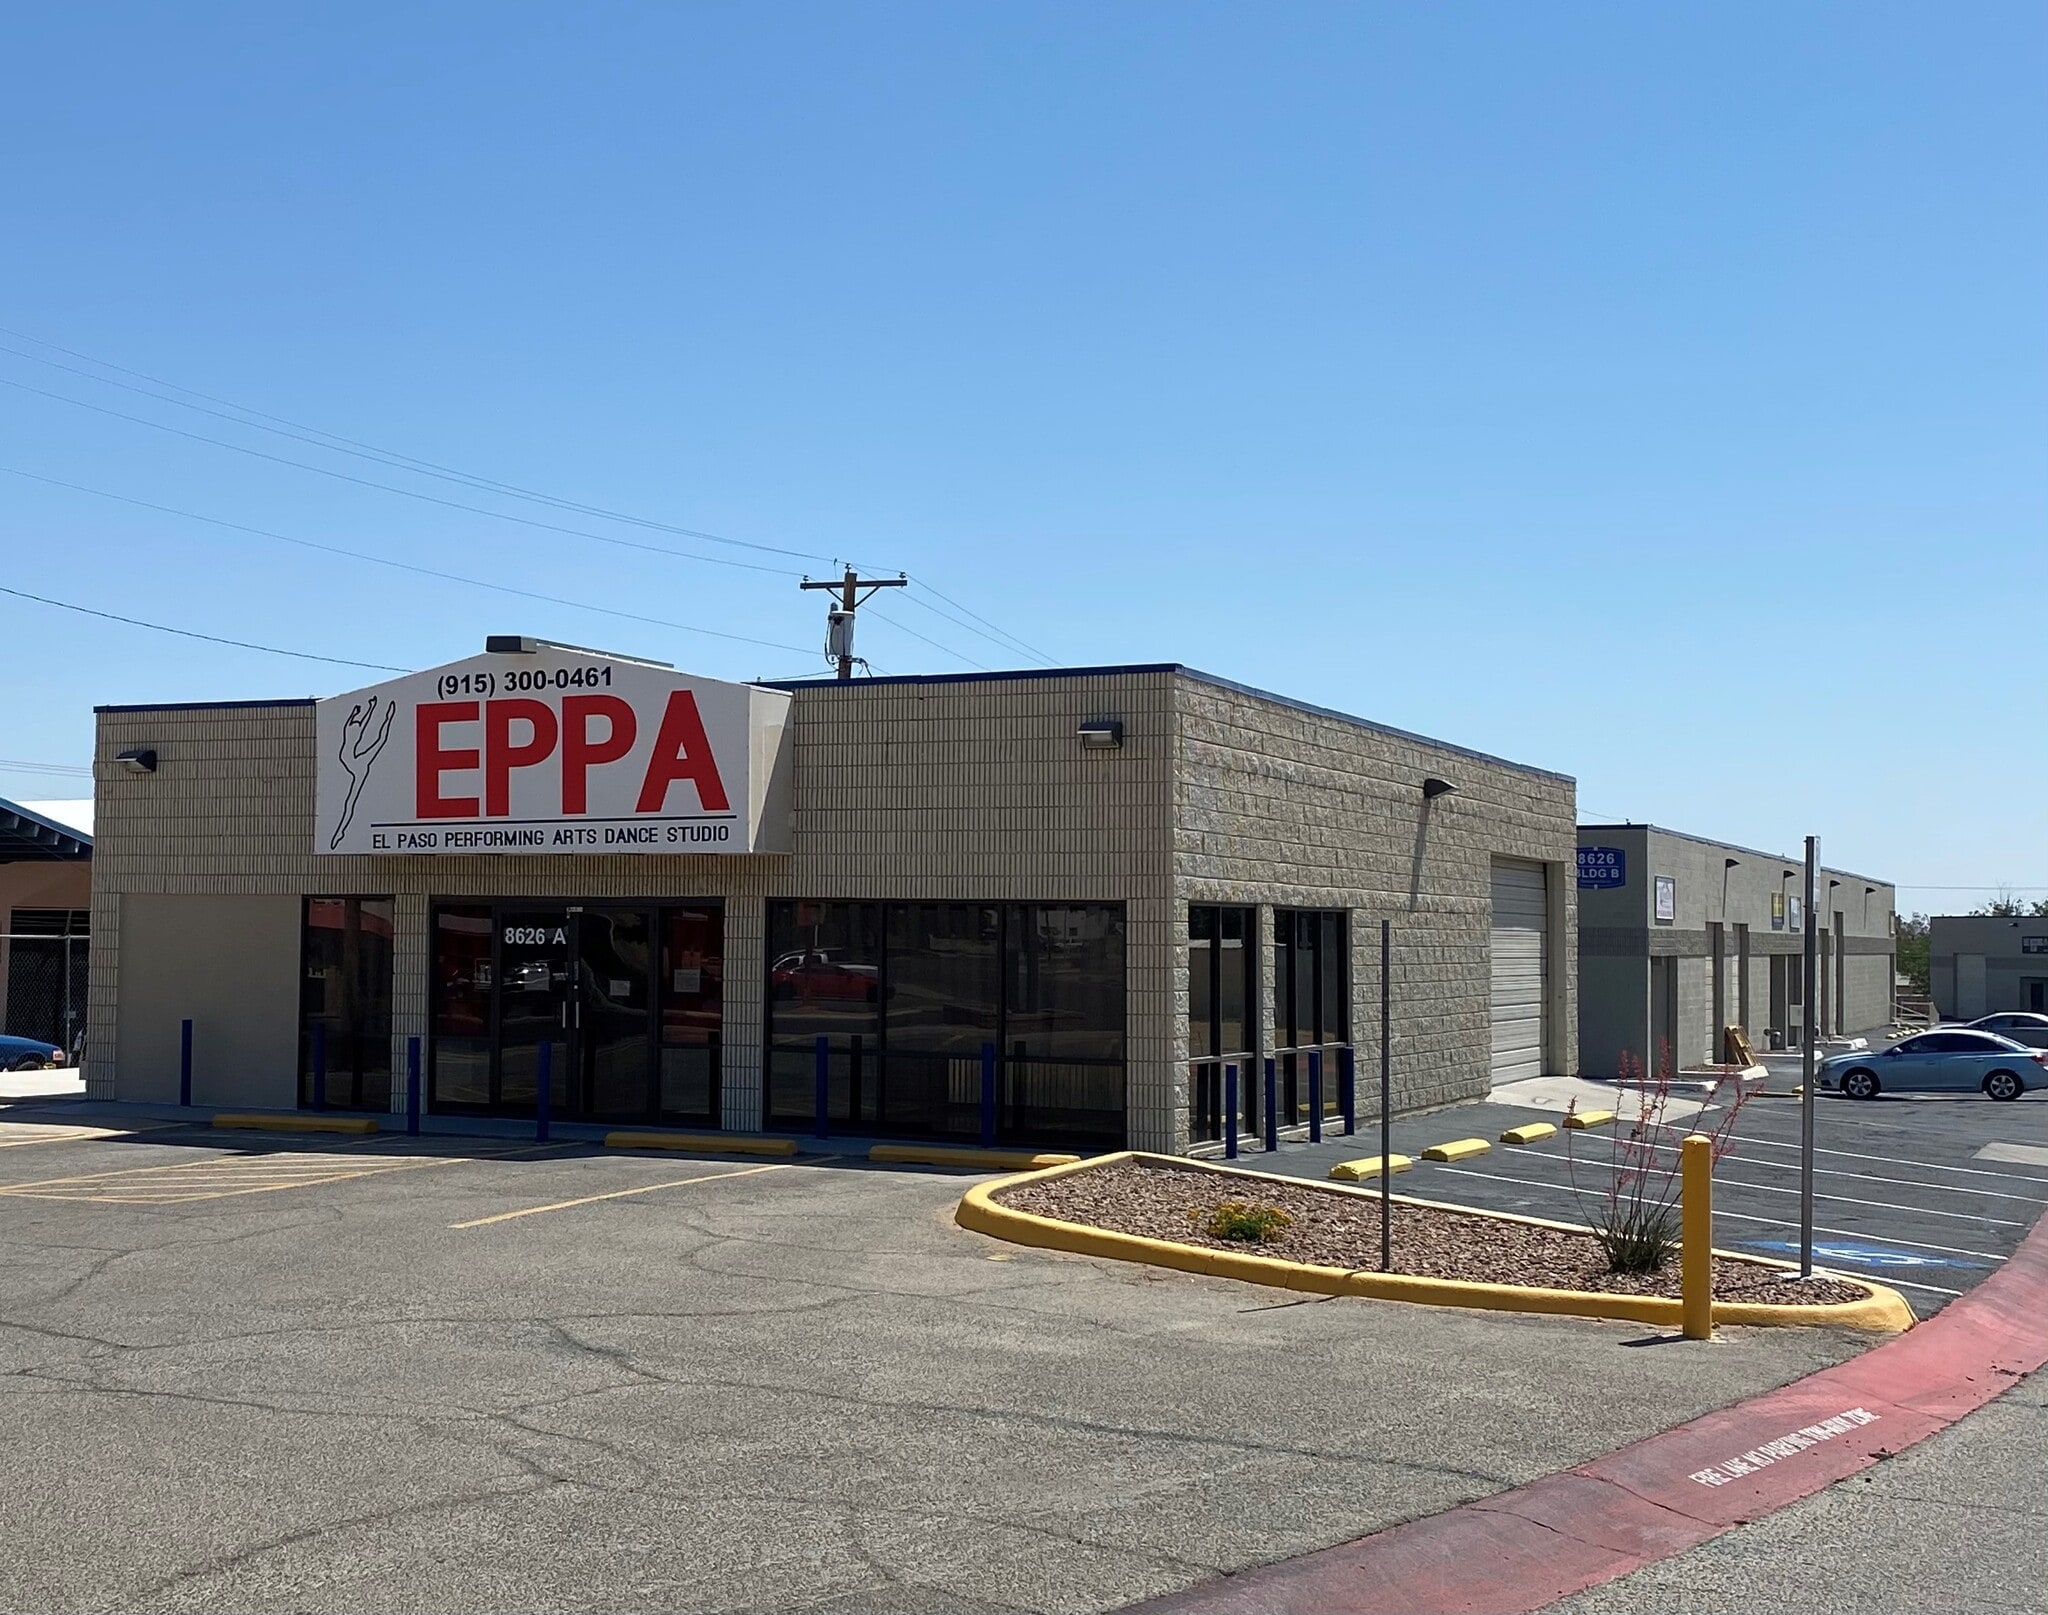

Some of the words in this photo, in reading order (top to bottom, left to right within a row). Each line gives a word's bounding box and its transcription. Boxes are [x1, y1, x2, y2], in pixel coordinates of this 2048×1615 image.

[437, 672, 496, 700] (915)
[503, 666, 613, 692] 300-0461
[416, 690, 731, 819] EPPA
[372, 836, 391, 850] EL
[397, 834, 438, 849] PASO
[444, 831, 544, 848] PERFORMING
[552, 828, 597, 846] ARTS
[604, 827, 658, 845] DANCE
[667, 825, 730, 843] STUDIO
[1578, 853, 1615, 864] 8626
[1611, 868, 1620, 878] B
[505, 927, 545, 944] 8626
[552, 928, 566, 944] A
[1687, 1468, 1732, 1488] FIRE
[1714, 1457, 1761, 1478] LANE
